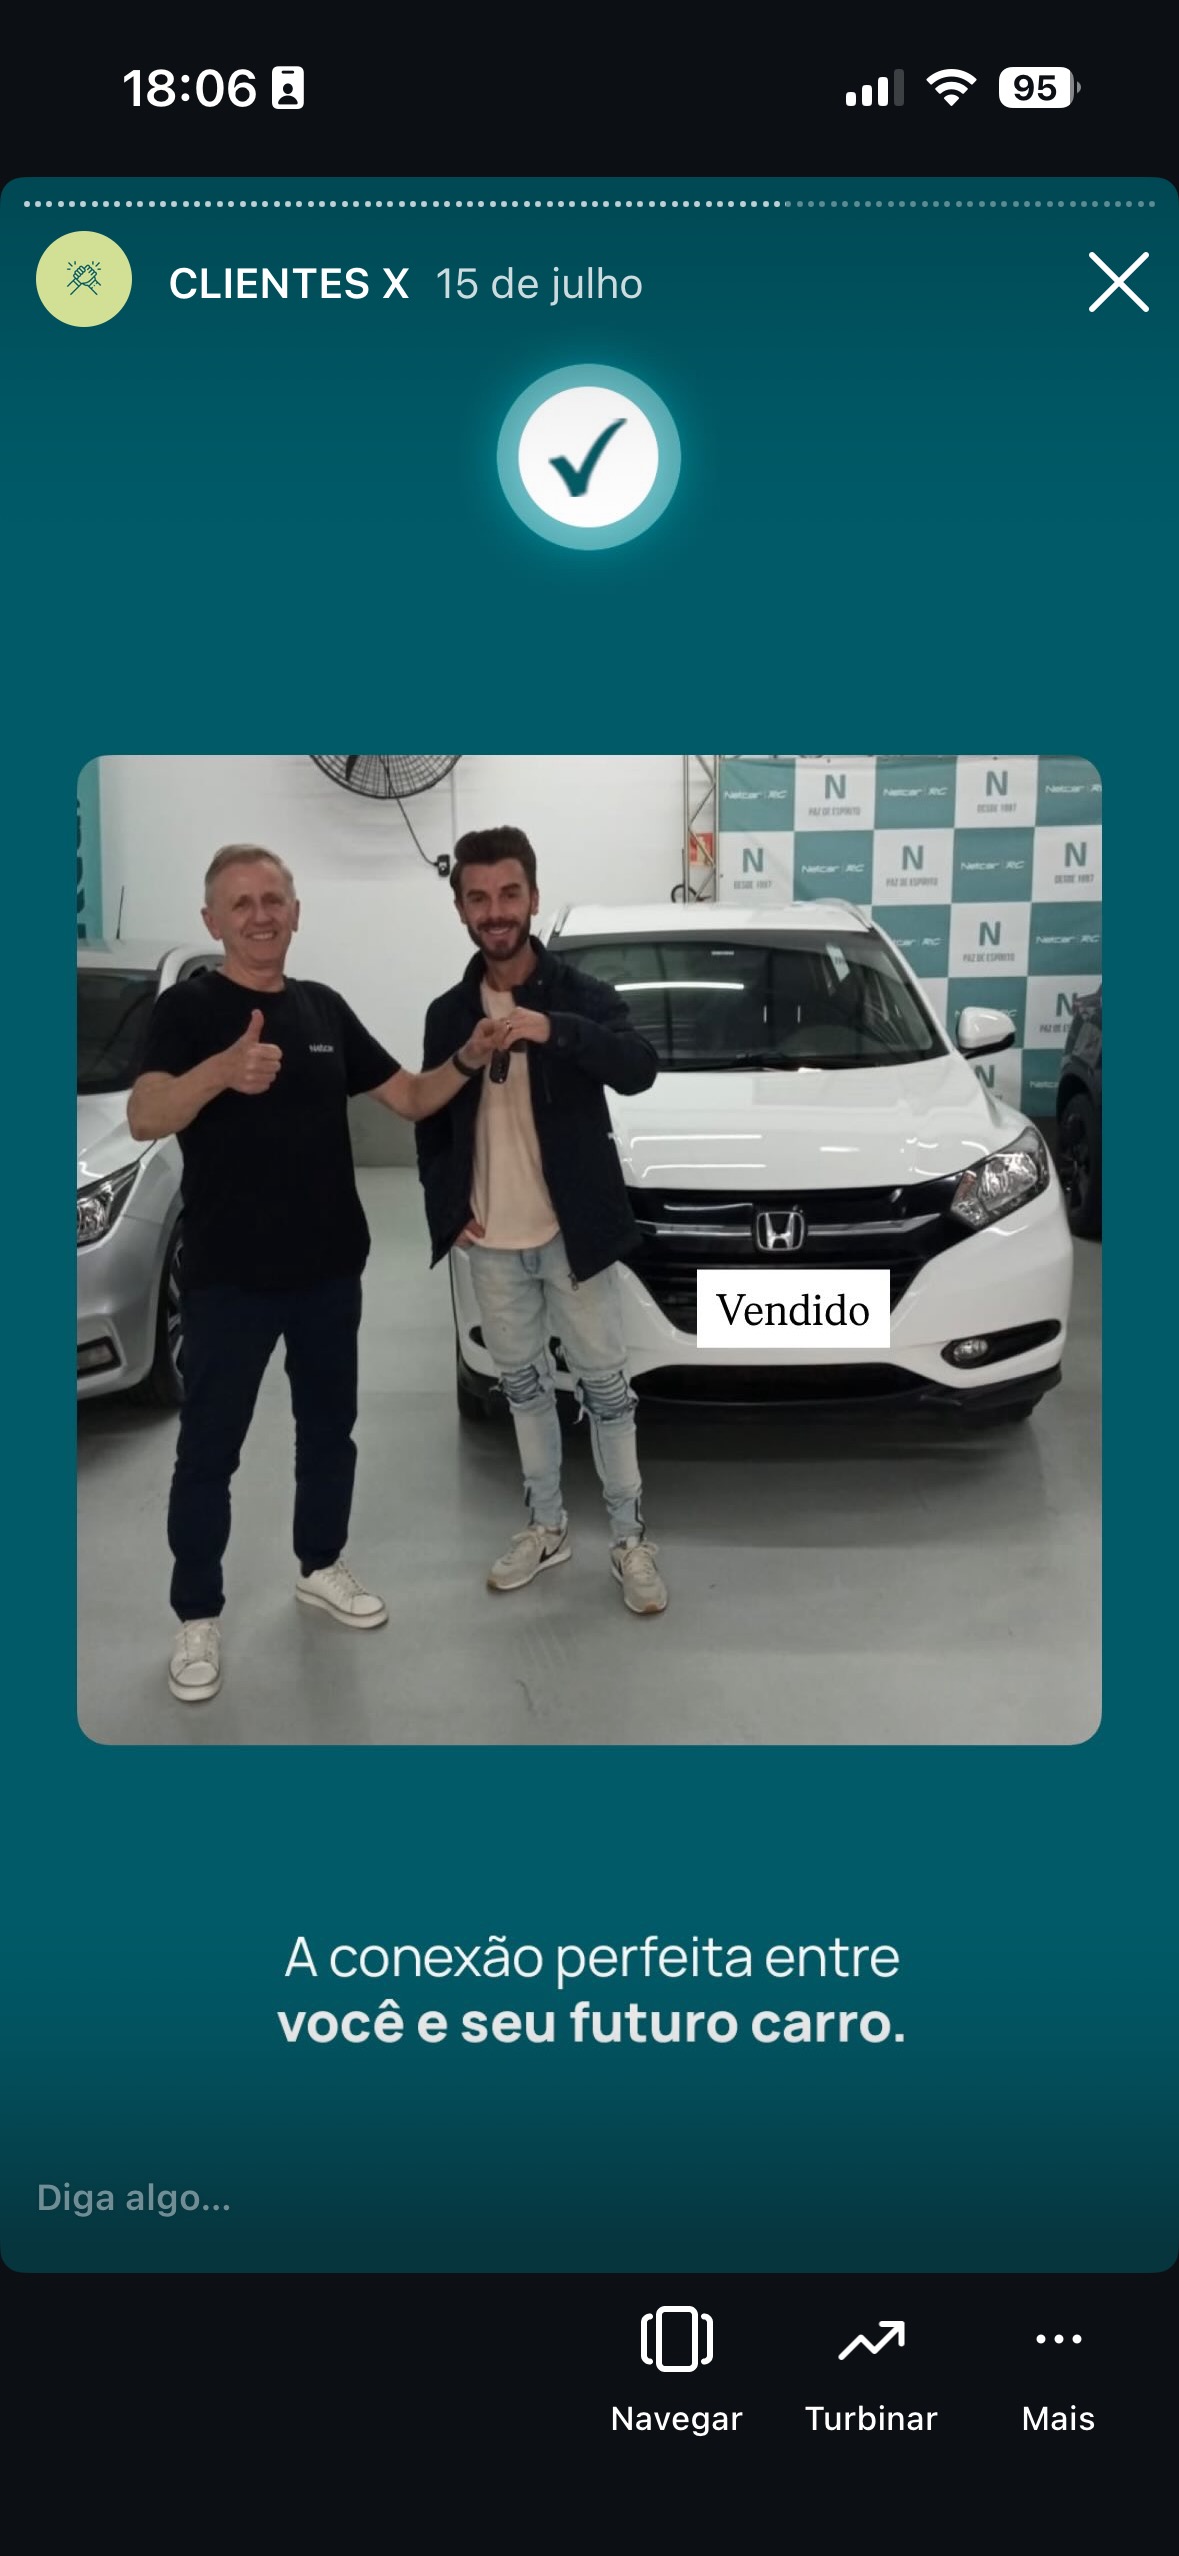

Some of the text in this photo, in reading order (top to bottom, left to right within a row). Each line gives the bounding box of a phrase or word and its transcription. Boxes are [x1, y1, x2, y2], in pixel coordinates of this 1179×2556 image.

[124, 69, 256, 107] 18:06
[1013, 75, 1057, 101] 95
[169, 266, 410, 300] CLIENTES X
[437, 266, 643, 307] 15 de julho
[824, 774, 847, 800] N
[986, 770, 1008, 796] N
[742, 848, 764, 873] N
[902, 845, 924, 871] N
[1064, 842, 1087, 867] N
[979, 921, 1001, 946] N
[37, 2182, 231, 2218] Diga algo...
[612, 2405, 744, 2437] Navegar
[804, 2404, 939, 2432] Turbinar
[1023, 2404, 1095, 2432] Mais
